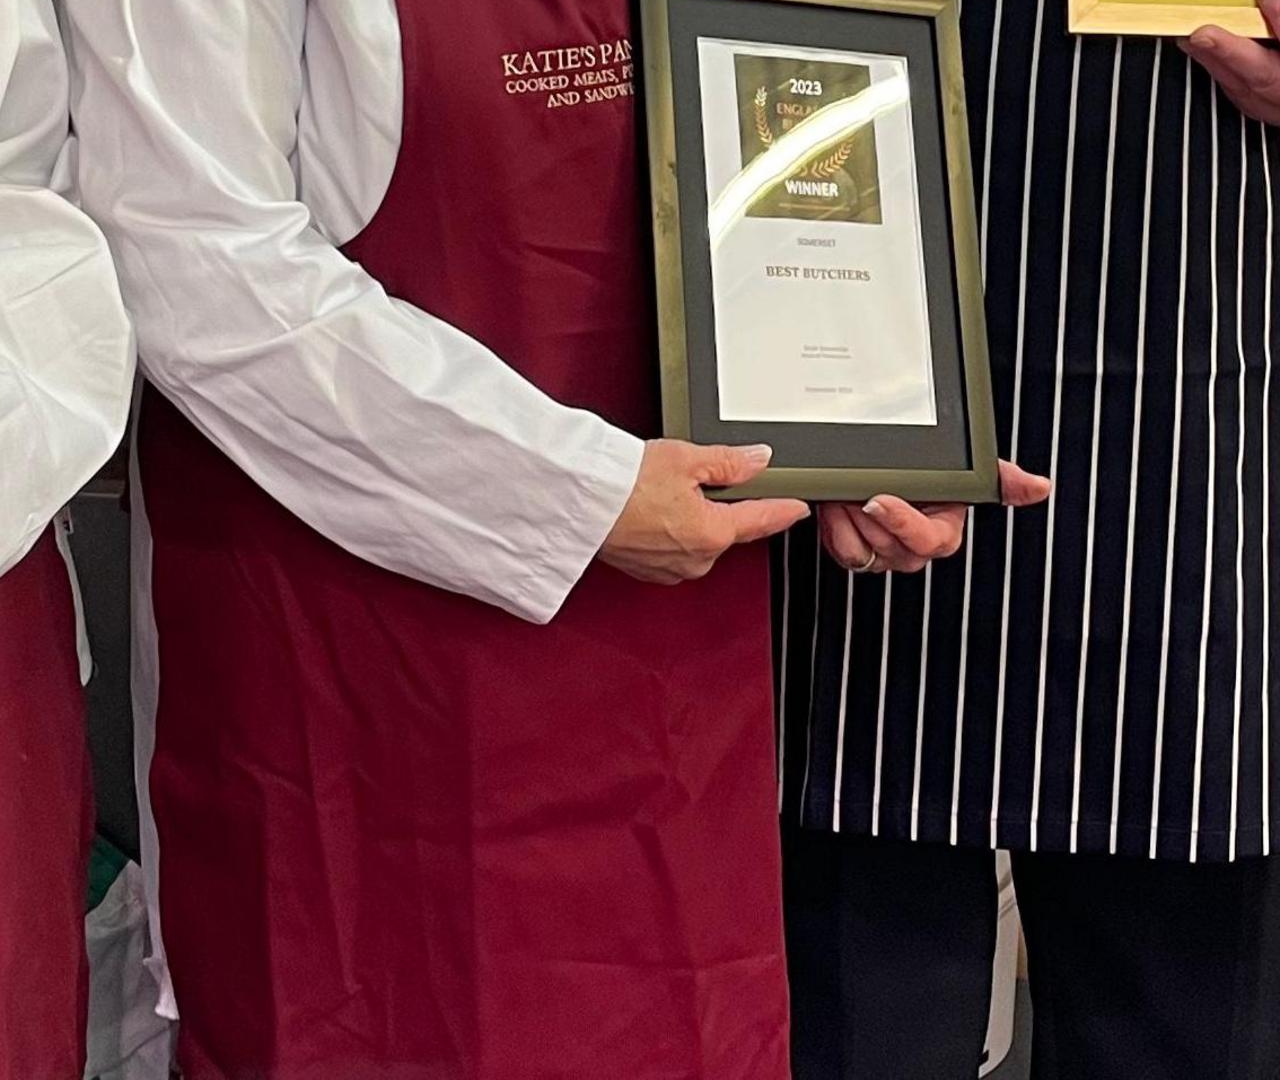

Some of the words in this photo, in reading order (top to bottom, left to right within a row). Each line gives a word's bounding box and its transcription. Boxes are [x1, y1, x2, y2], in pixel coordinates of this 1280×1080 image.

[501, 45, 596, 77] KATIE'S
[599, 39, 633, 65] PAN
[505, 74, 570, 94] COOKED
[573, 68, 619, 87] MEATS,
[789, 78, 823, 96] 2023
[547, 91, 581, 108] AND
[584, 82, 635, 104] SANDWI
[784, 179, 839, 197] WINNER
[765, 265, 799, 278] BEST
[803, 267, 871, 281] BUTCHERS
